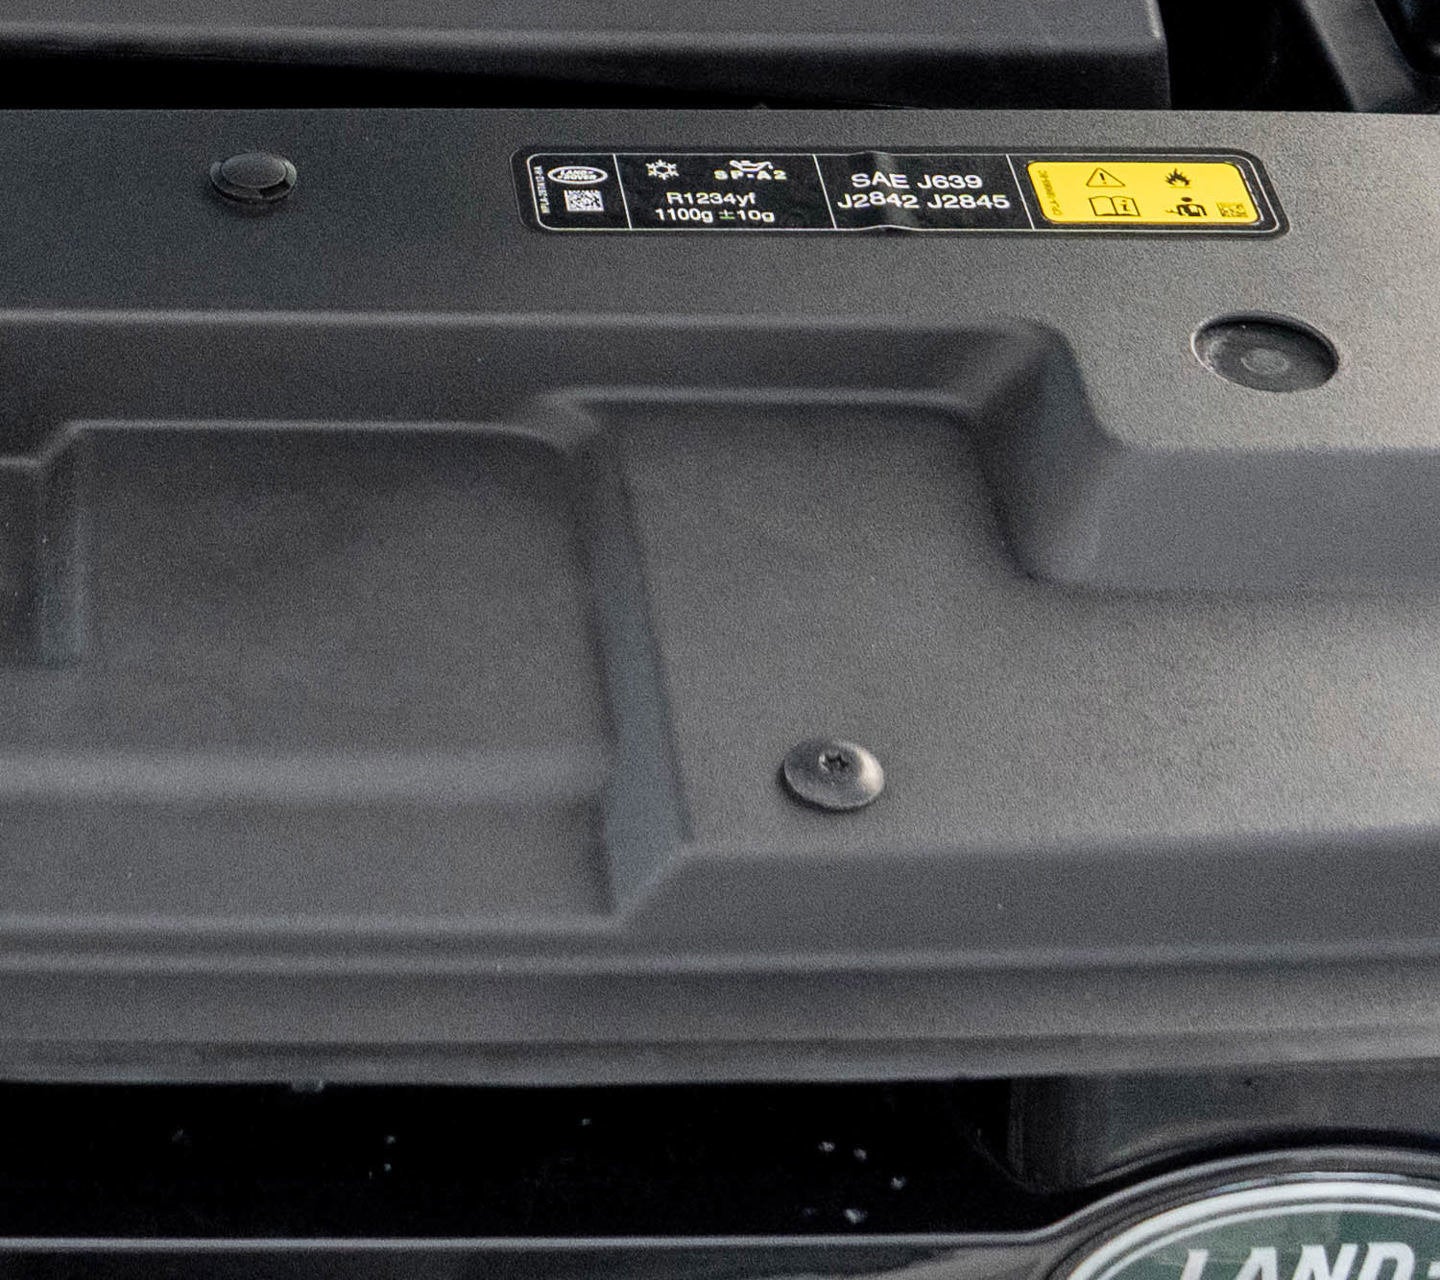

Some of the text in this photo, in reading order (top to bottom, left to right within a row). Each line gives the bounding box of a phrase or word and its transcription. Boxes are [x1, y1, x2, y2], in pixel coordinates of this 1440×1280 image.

[713, 169, 787, 181] SP-A2
[851, 171, 983, 189] SAE J639
[666, 191, 757, 207] R1234yf
[837, 191, 1011, 209] J2842 J2845
[655, 207, 714, 223] 1100g
